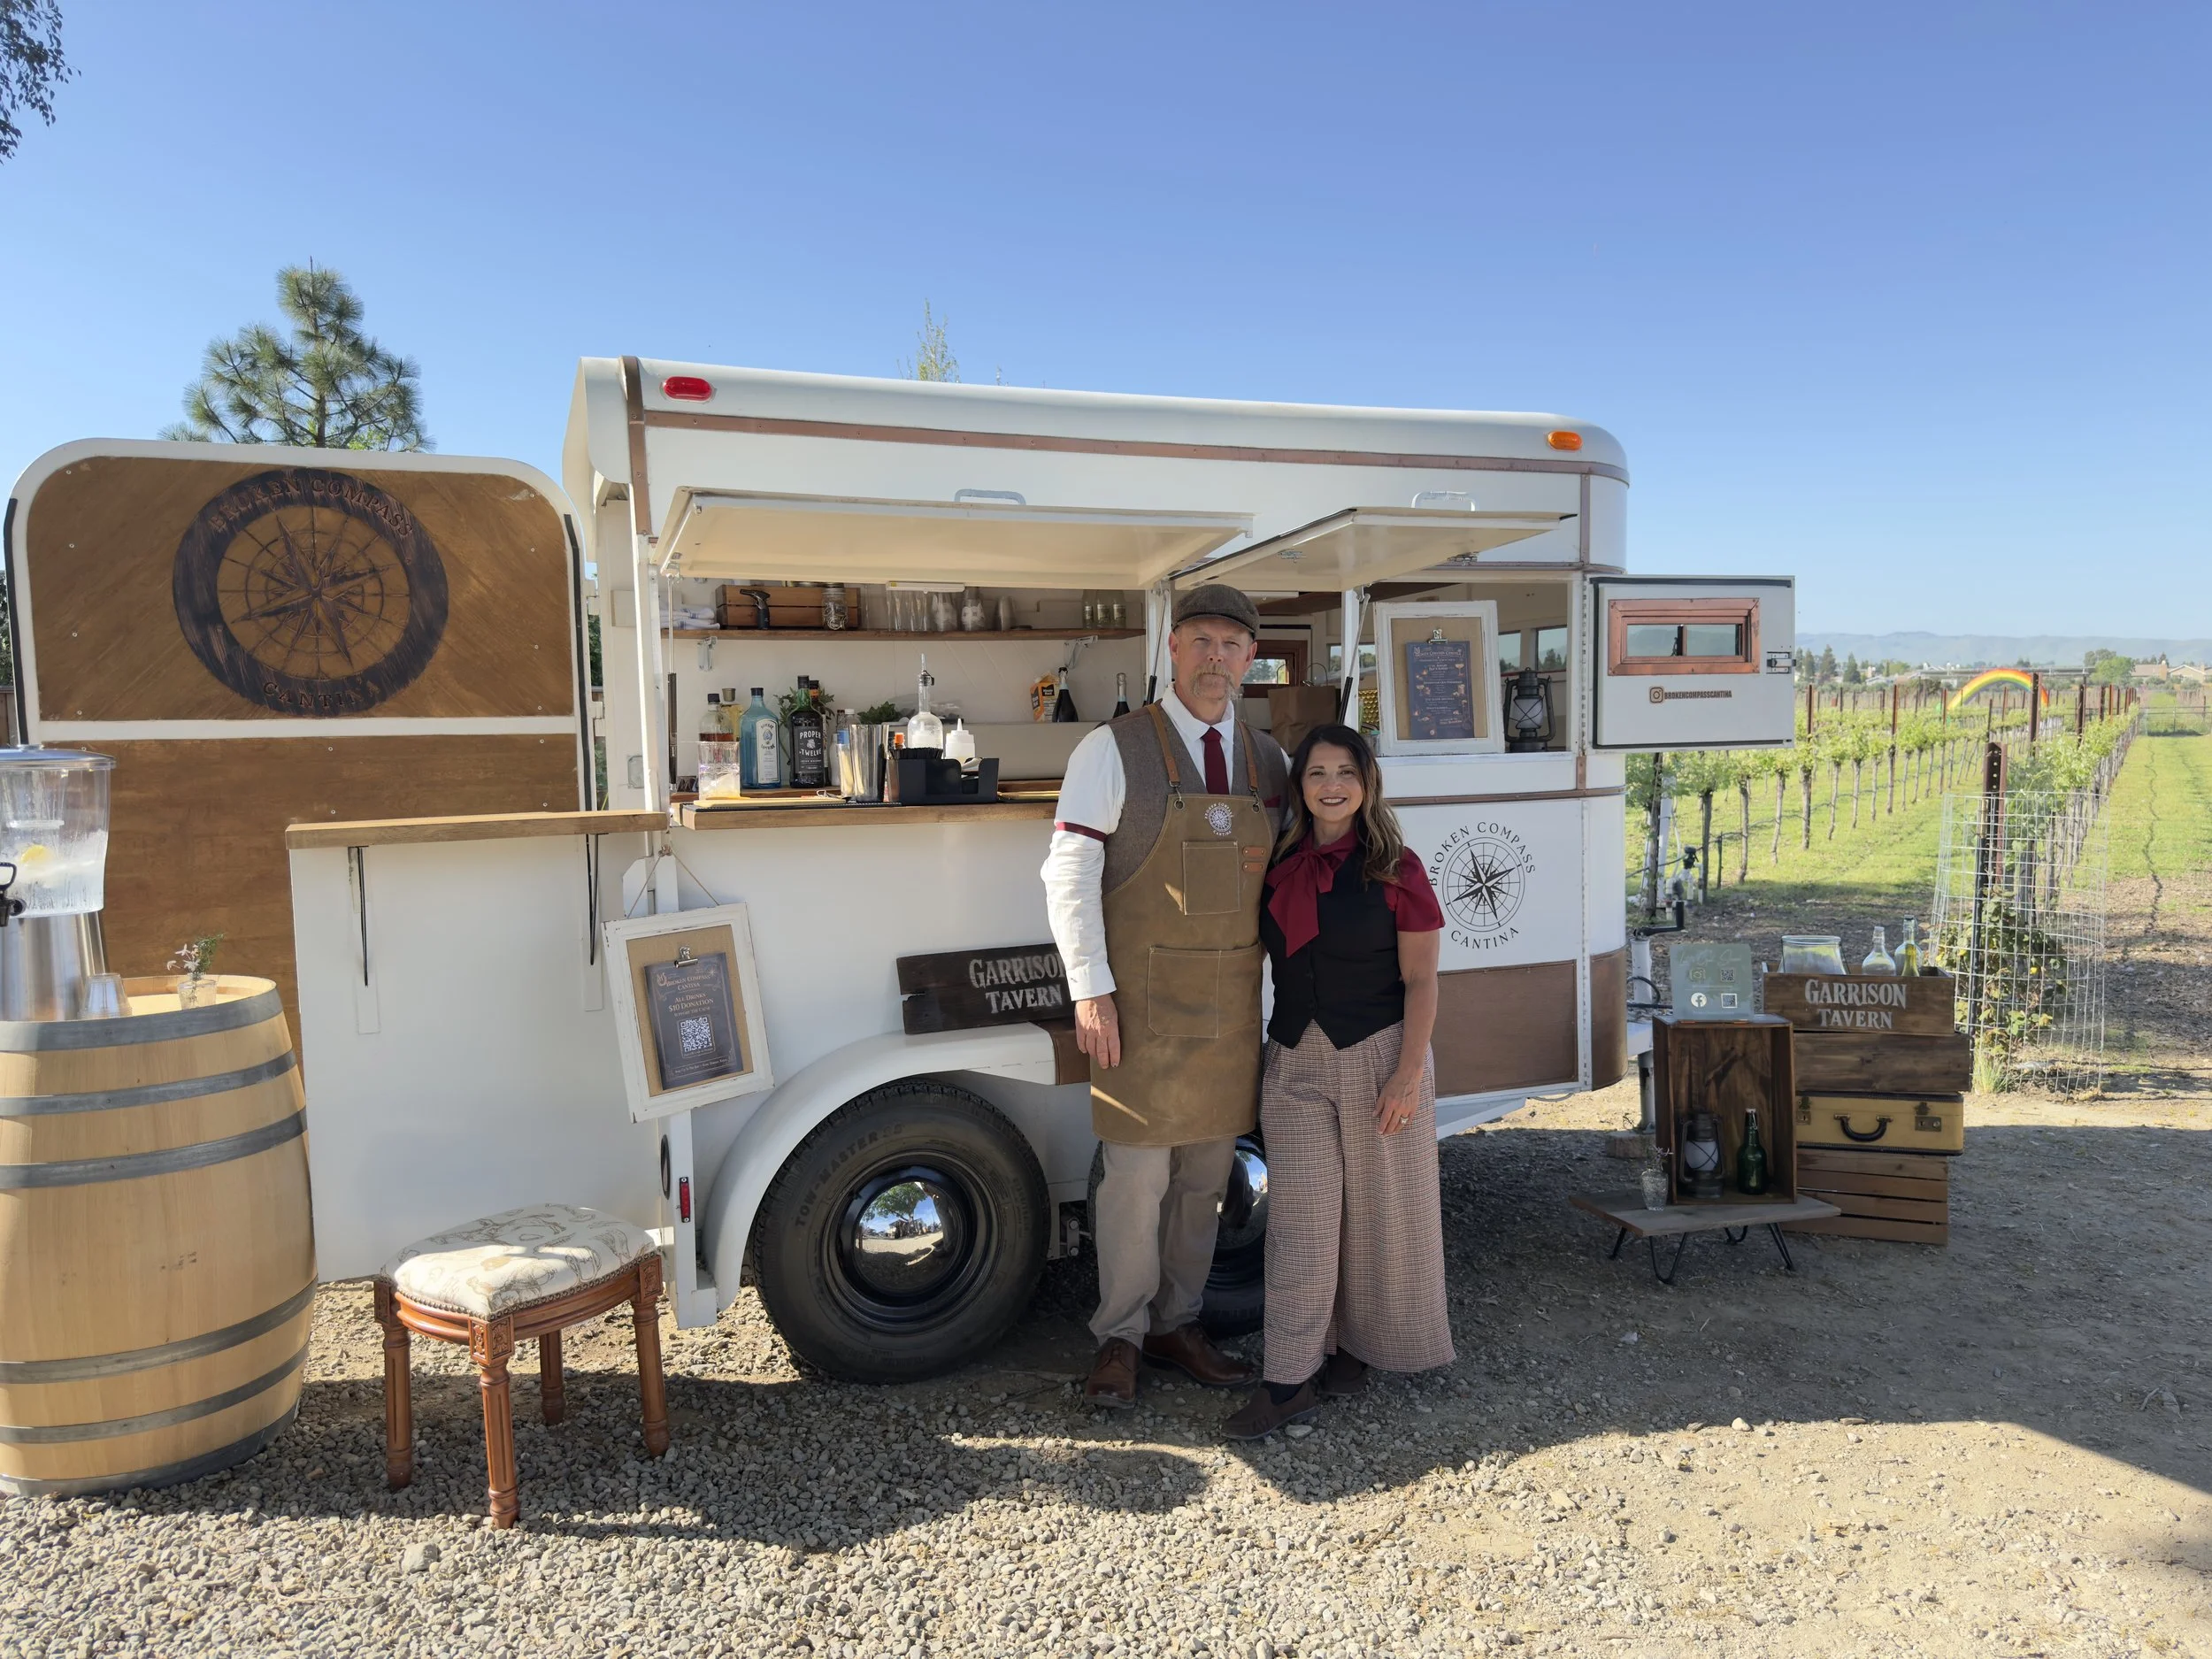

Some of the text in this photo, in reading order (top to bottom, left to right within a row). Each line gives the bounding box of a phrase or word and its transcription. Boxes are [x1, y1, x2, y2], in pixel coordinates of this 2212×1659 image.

[208, 478, 415, 537] BROKEN COMPASS
[262, 680, 381, 708] CANTINA
[1664, 690, 1732, 700] BROKENCOMPASSCANTINA
[799, 730, 822, 740] PROPER
[1430, 821, 1536, 887] BROKEN COMPASS
[1450, 926, 1519, 949] CANTINA
[986, 984, 1063, 1014] TAVERN
[1805, 979, 1908, 1010] GARRISON
[1817, 1009, 1893, 1029] TAVERN
